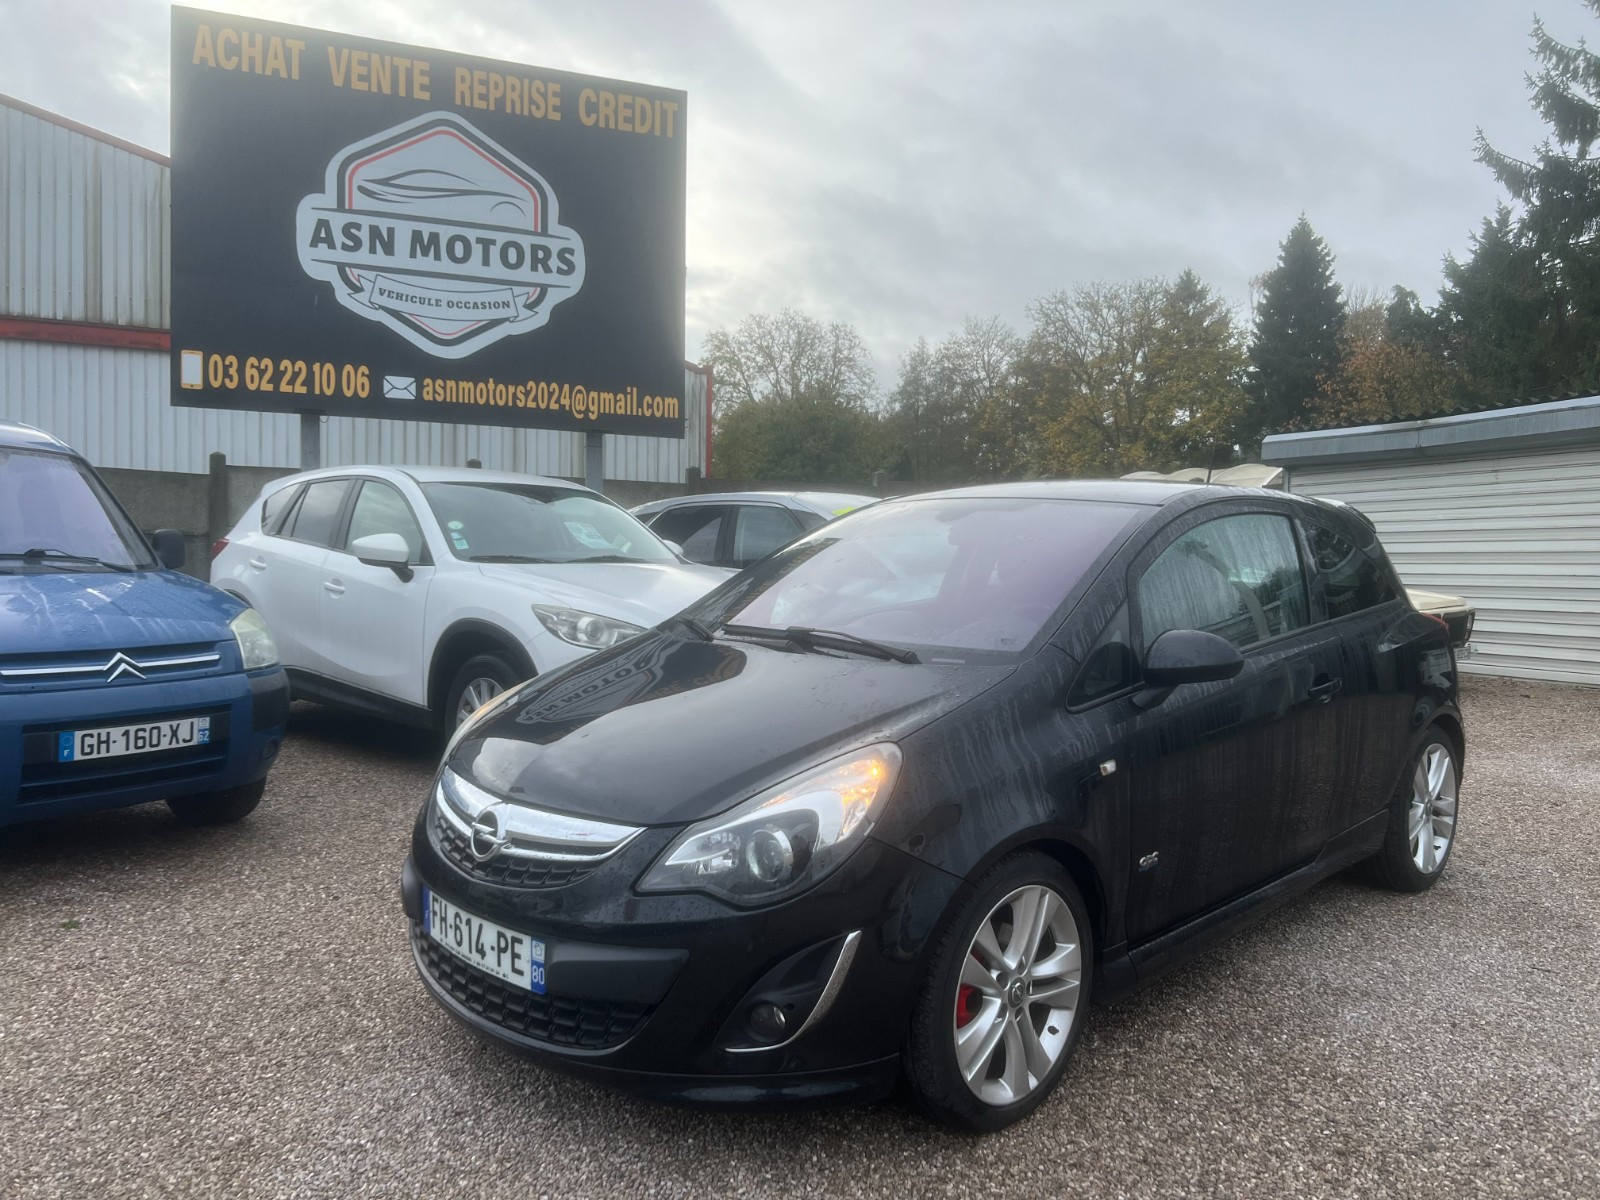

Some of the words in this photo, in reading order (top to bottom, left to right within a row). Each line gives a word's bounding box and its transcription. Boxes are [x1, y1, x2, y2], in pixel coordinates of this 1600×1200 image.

[192, 24, 306, 80] ACHAT
[327, 45, 431, 101] VENTE
[455, 67, 562, 121] REPRISE
[578, 88, 679, 138] CREDIT
[309, 218, 395, 257] ASN
[409, 229, 576, 276] MOTORS
[378, 287, 442, 308] VEHICULE
[446, 300, 511, 310] OCCASION
[208, 354, 239, 389] 03
[245, 356, 274, 392] 62
[279, 359, 307, 394] 22
[312, 362, 336, 396] 10
[341, 364, 370, 398] 06
[422, 377, 679, 420] asnmotors2024@gmail.com
[63, 749, 70, 757] F
[80, 721, 195, 757] GH-160-XJ
[431, 894, 525, 977] FH-614-PE
[531, 964, 545, 985] 80
